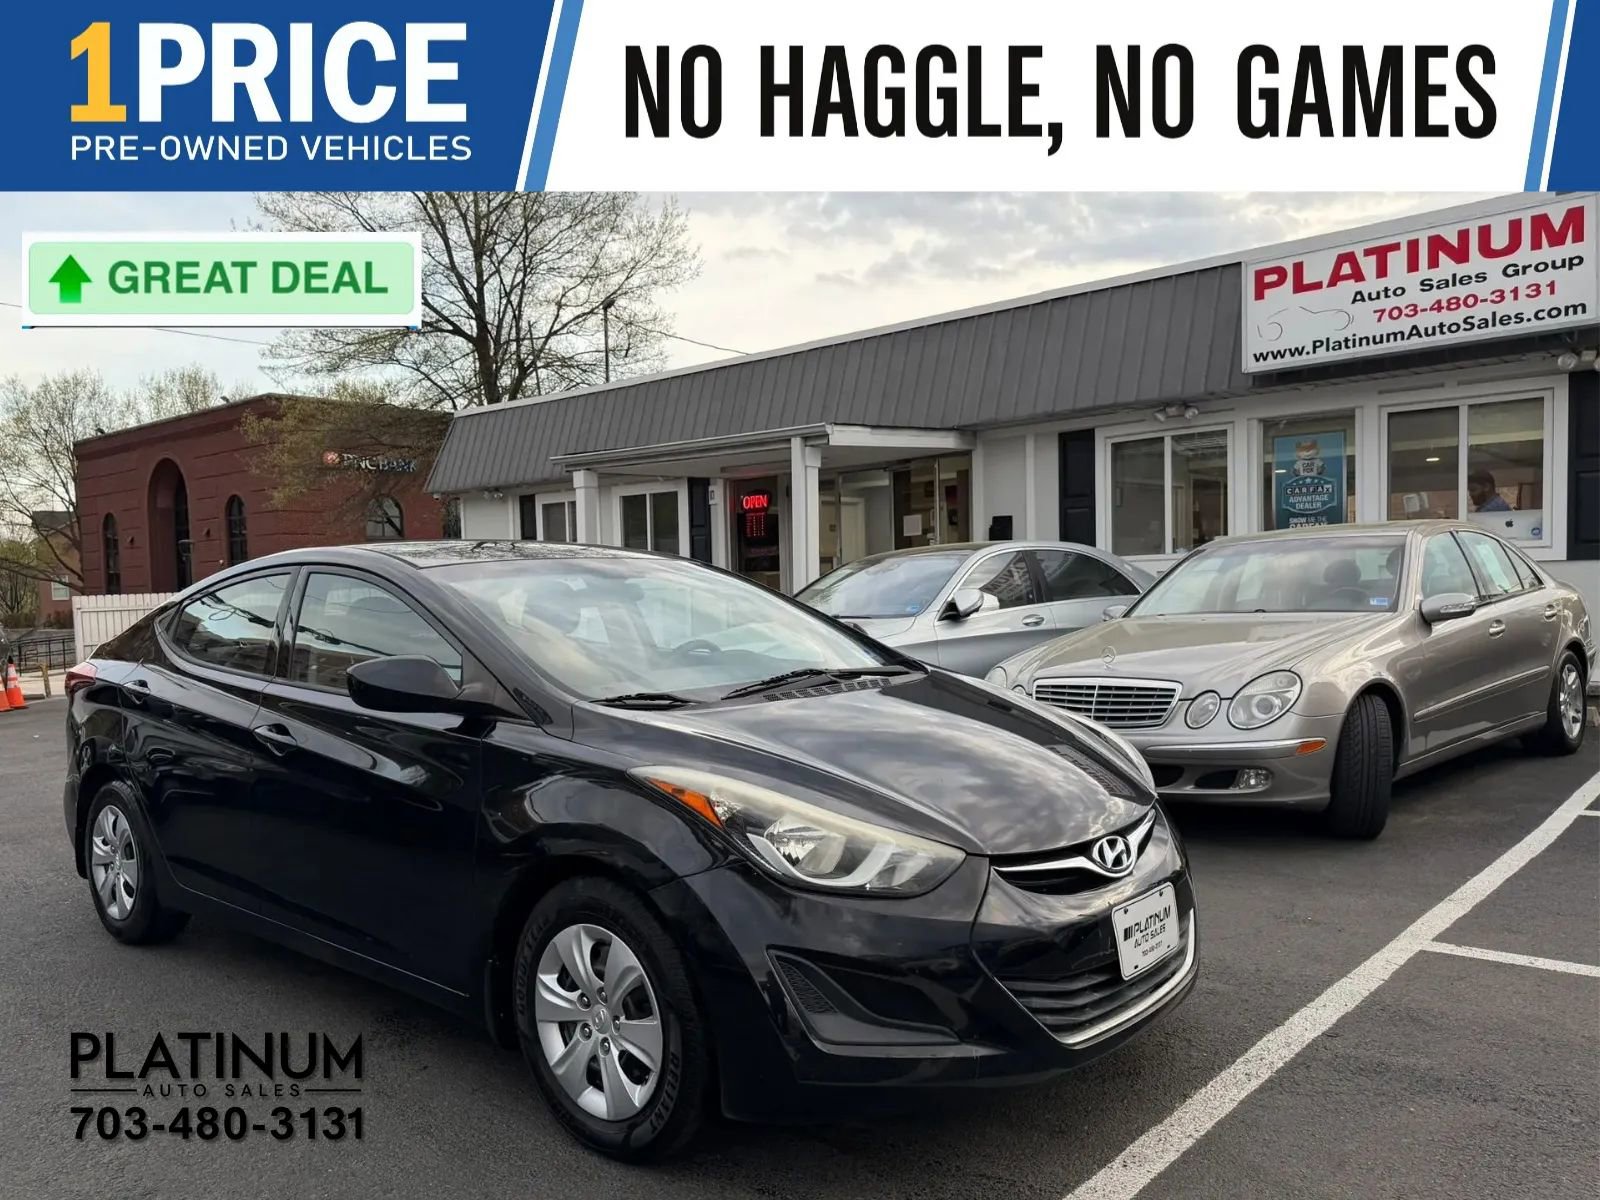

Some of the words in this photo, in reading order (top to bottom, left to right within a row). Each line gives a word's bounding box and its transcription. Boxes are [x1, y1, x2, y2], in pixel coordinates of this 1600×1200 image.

[1254, 205, 1585, 301] PLATINUM
[1351, 285, 1406, 304] Auto
[1419, 271, 1488, 293] Sales
[1502, 254, 1585, 279] Group
[1373, 280, 1557, 323] 703-480-3131
[1253, 301, 1587, 363] www.PlatinumAutoSales.com
[743, 494, 769, 509] OPEN
[1286, 485, 1332, 495] CARFAX
[1289, 494, 1329, 503] ADVANTAGE
[1133, 904, 1171, 937] PLATINUM
[1134, 932, 1149, 948] AUTO
[1150, 923, 1166, 941] SALES
